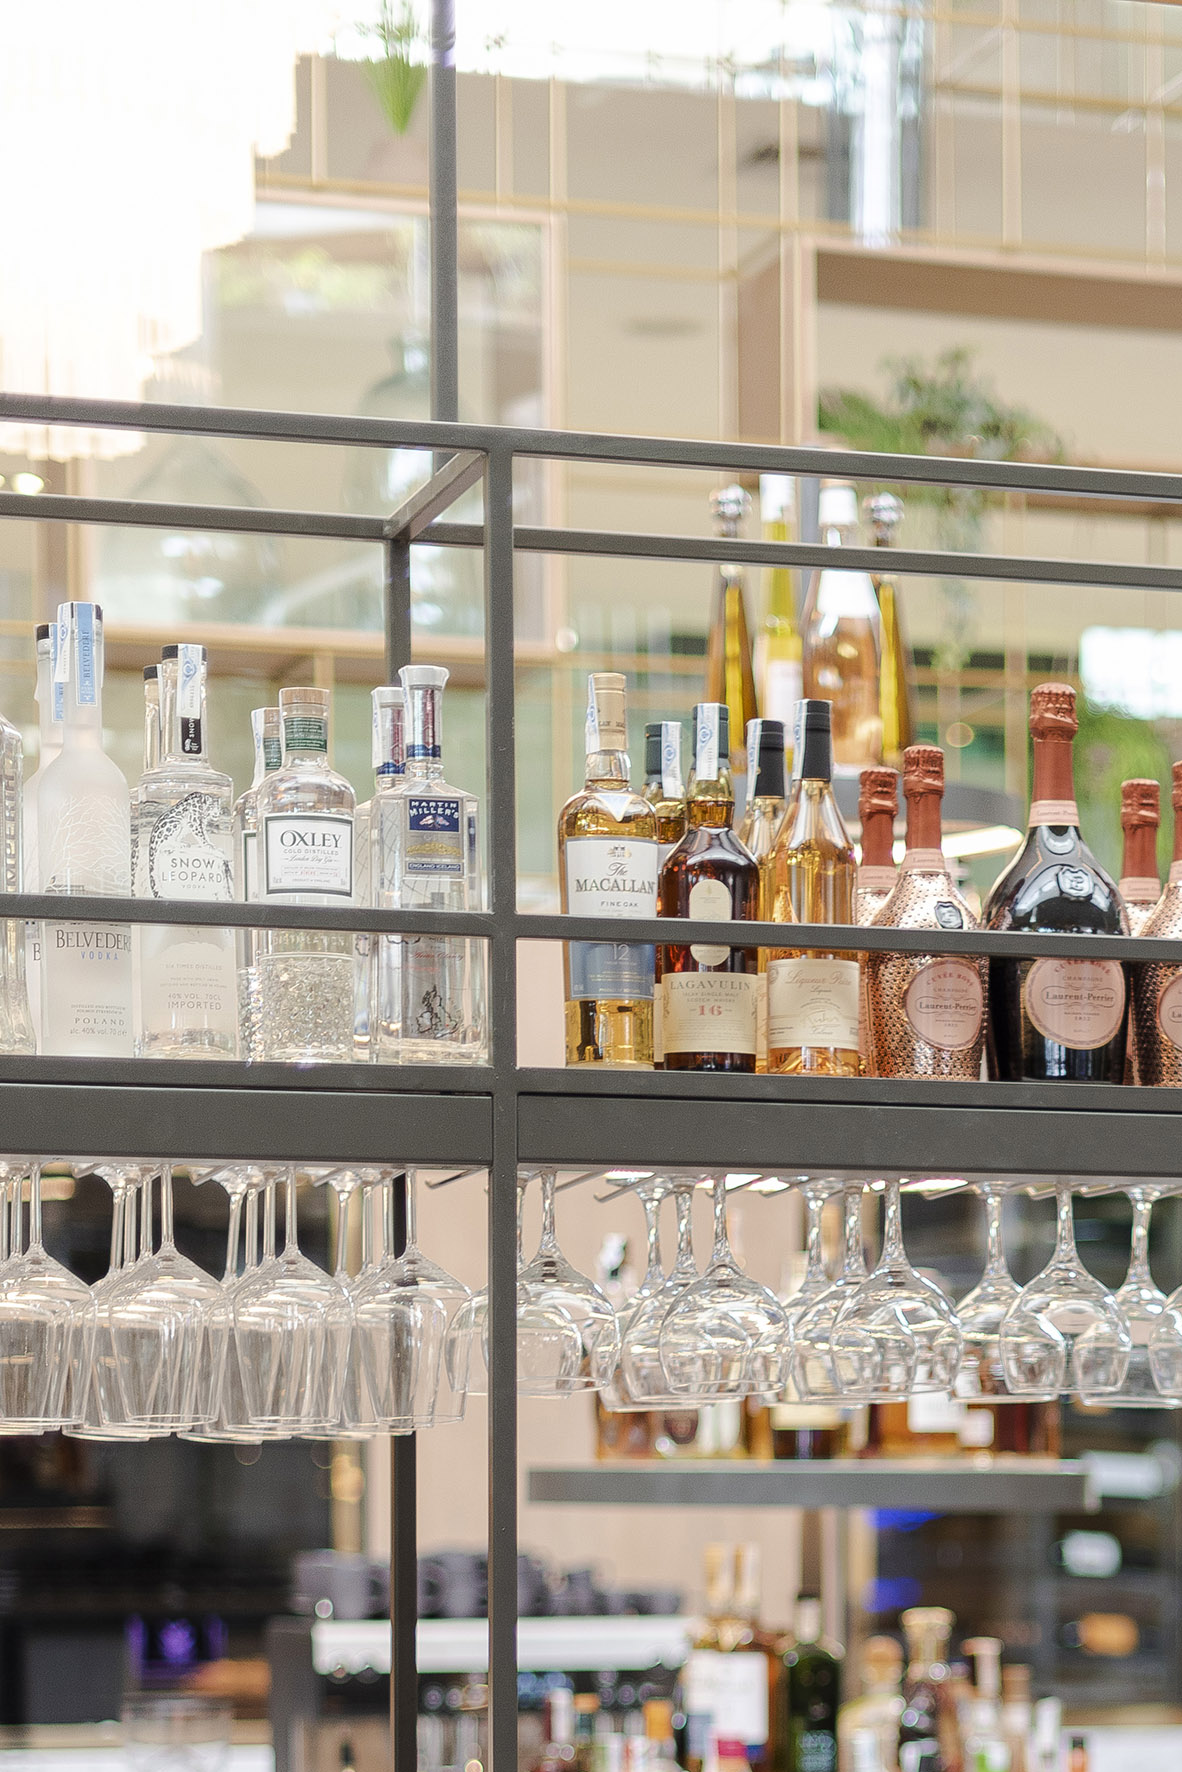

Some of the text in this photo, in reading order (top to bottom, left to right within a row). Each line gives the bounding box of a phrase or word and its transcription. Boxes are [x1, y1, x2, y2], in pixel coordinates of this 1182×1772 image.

[410, 801, 458, 809] MARTIN
[409, 808, 460, 819] MILLER'S
[280, 829, 343, 850] OXLEY
[304, 848, 340, 856] DISTILLED
[170, 857, 216, 870] SNOW
[607, 861, 628, 878] The
[161, 870, 223, 884] LEOPARD
[575, 878, 655, 895] MACALLAN
[600, 900, 621, 908] FINE
[80, 951, 119, 960] VODKA
[612, 943, 630, 961] 12
[670, 980, 751, 991] LAGAVULIN
[1045, 990, 1114, 1003] Laurent-Perrier
[167, 1000, 222, 1011] IMPORTED
[697, 1004, 723, 1017] 16
[74, 1016, 125, 1026] POLAND
